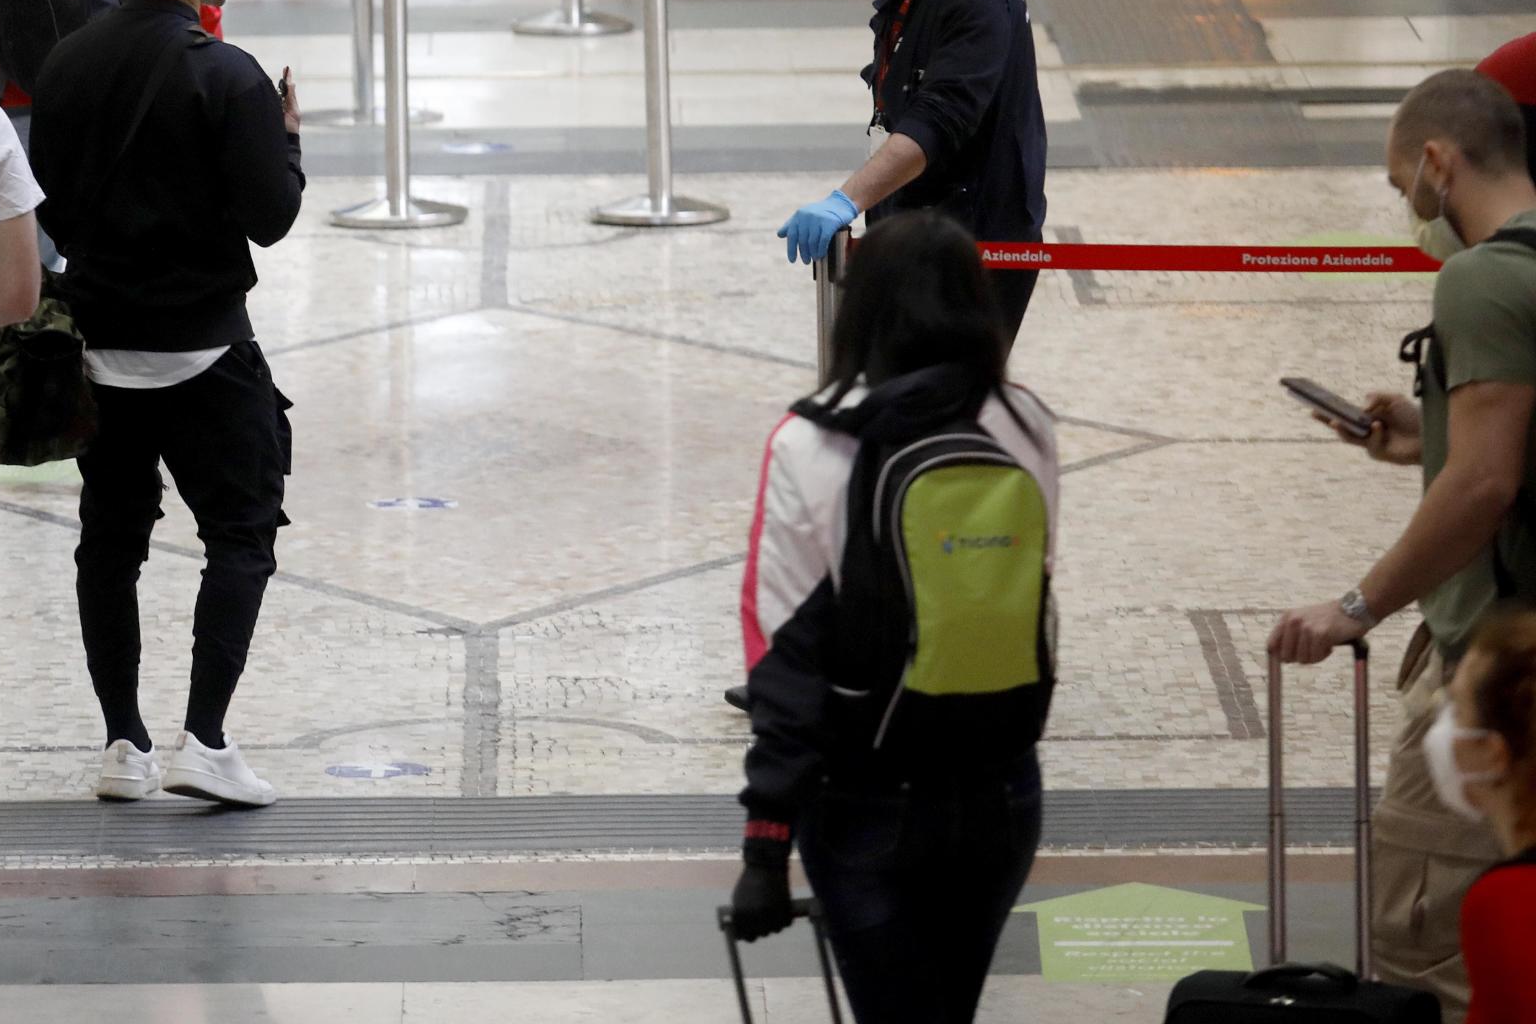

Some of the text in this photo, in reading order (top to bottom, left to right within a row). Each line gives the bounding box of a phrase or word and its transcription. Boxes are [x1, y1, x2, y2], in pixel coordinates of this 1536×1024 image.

[982, 249, 1052, 263] Aziendale
[1242, 254, 1393, 266] Protezione Aziendale
